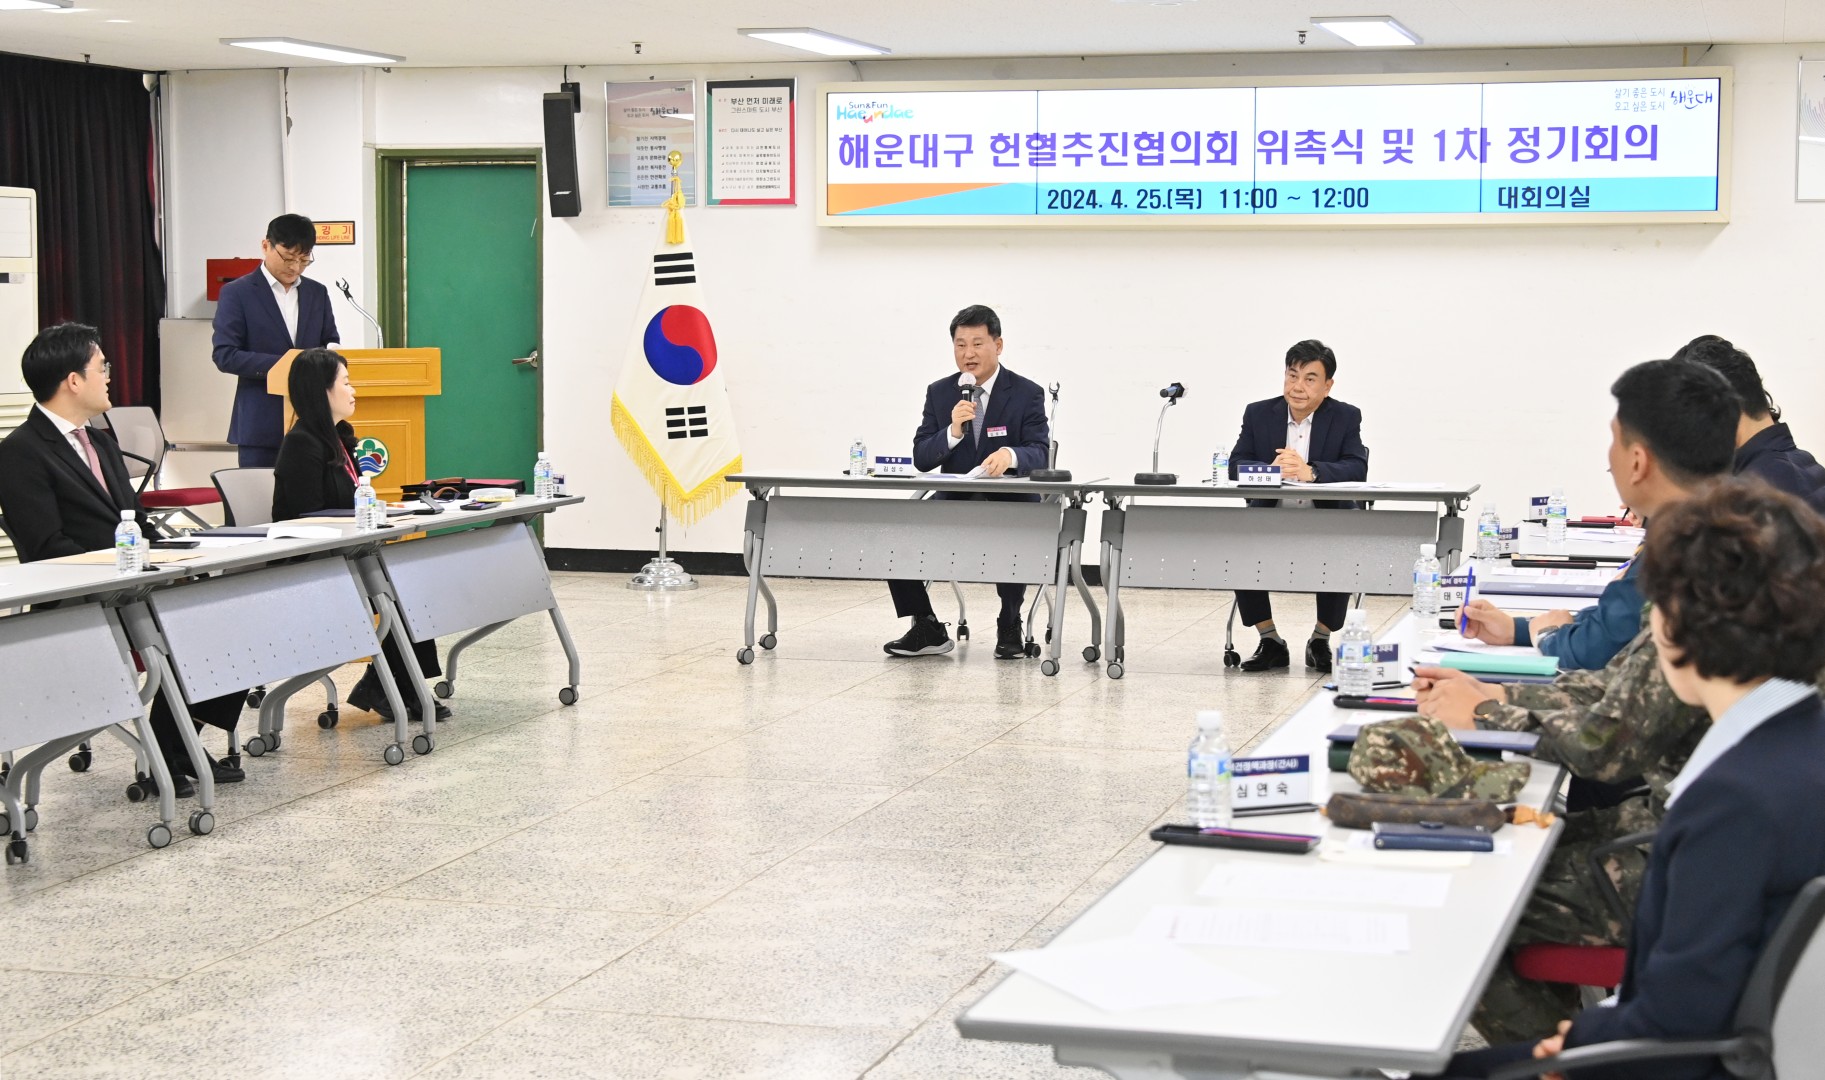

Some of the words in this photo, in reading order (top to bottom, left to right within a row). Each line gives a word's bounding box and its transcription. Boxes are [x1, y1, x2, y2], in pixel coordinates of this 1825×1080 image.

[1632, 87, 1647, 98] 좋은
[1650, 87, 1665, 97] 도시
[730, 97, 745, 106] 부산
[746, 97, 760, 106] 먼저
[762, 96, 783, 105] 미래로
[848, 101, 888, 109] Sun&Fun
[1614, 101, 1630, 111] 오고
[1632, 100, 1647, 112] 싶은
[1650, 101, 1665, 111] 도시
[836, 105, 914, 123] Haeundae
[838, 134, 974, 169] 해운대구
[989, 130, 1238, 168] 헌혈추진협의회
[1256, 129, 1363, 165] 위촉식
[1382, 129, 1414, 165] 및
[1433, 126, 1492, 165] 1차
[1507, 124, 1658, 164] 정기회의
[1047, 189, 1103, 210] 2024.
[1110, 189, 1128, 209] 4.
[1136, 188, 1202, 210] 25.(목)
[1219, 188, 1277, 209] 11:00
[1312, 187, 1369, 208] 12:00
[1498, 186, 1590, 209] 대회의실
[1236, 781, 1288, 799] 심연숙
